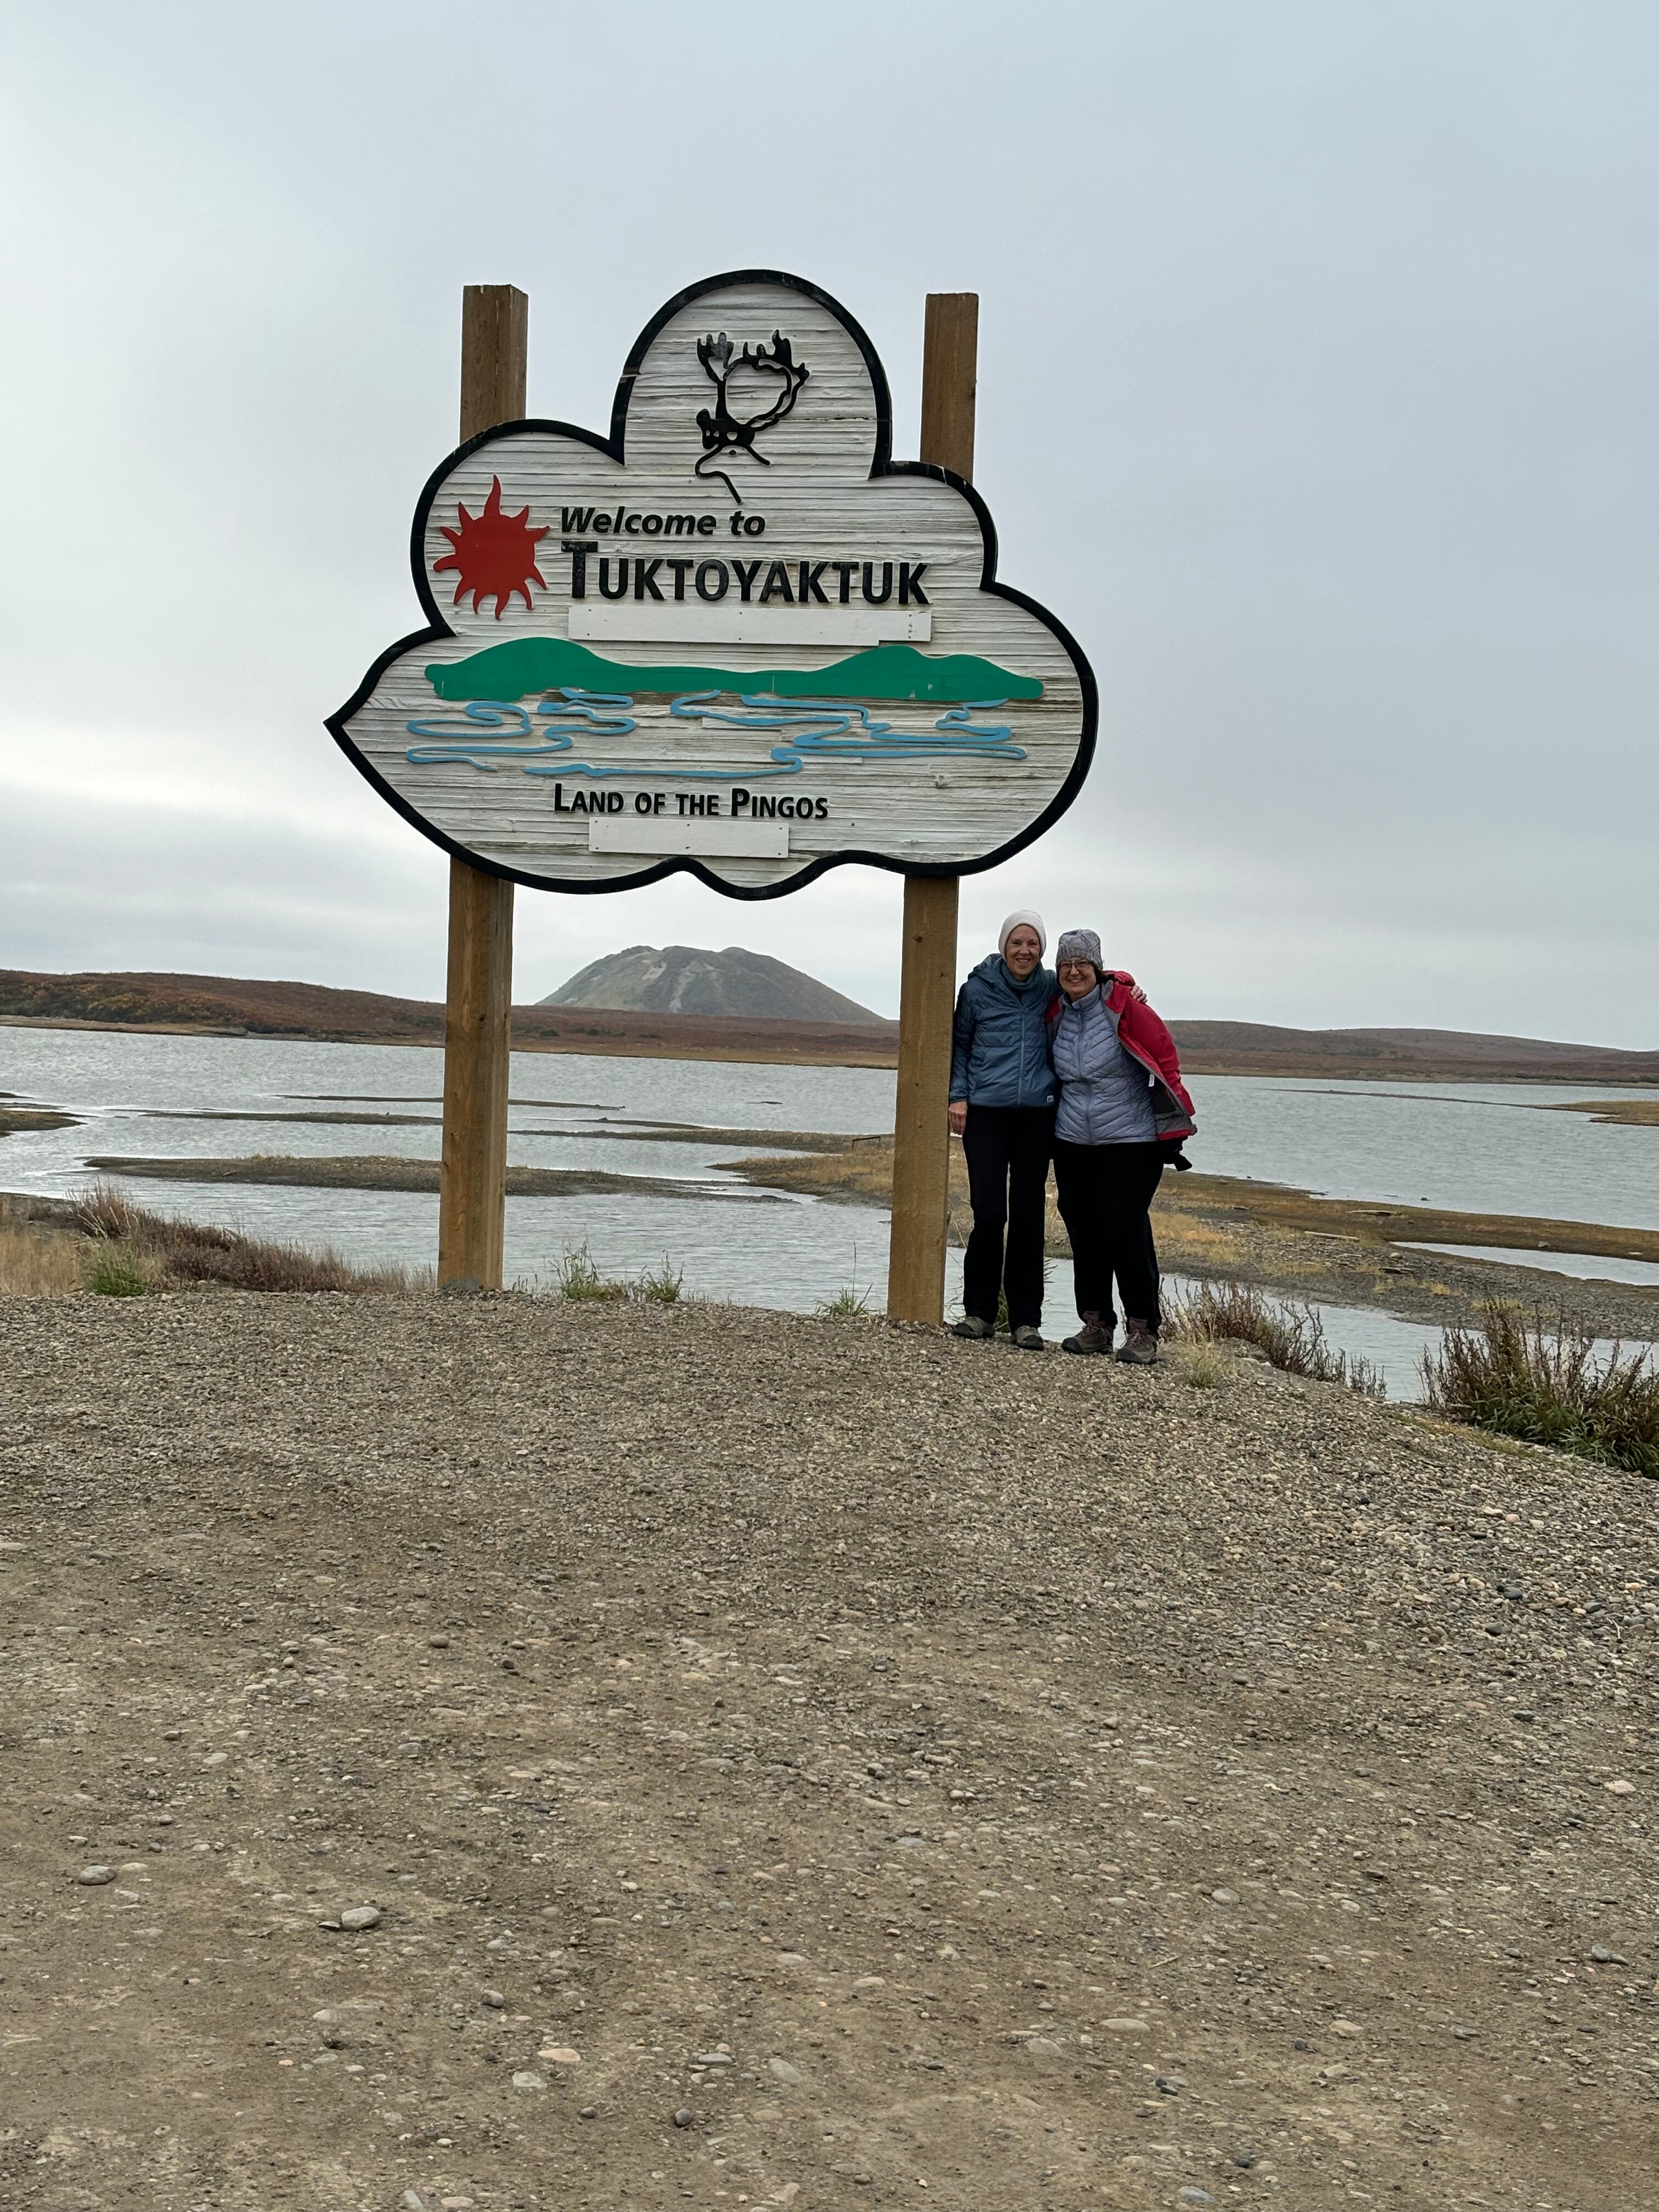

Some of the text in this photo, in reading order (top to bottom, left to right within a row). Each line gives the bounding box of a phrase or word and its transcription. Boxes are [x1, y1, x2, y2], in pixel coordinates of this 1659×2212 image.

[561, 506, 766, 537] Welcome to
[561, 540, 932, 605] TUKTOYAKTUK
[554, 783, 829, 820] LAND OF THE PINGOS
